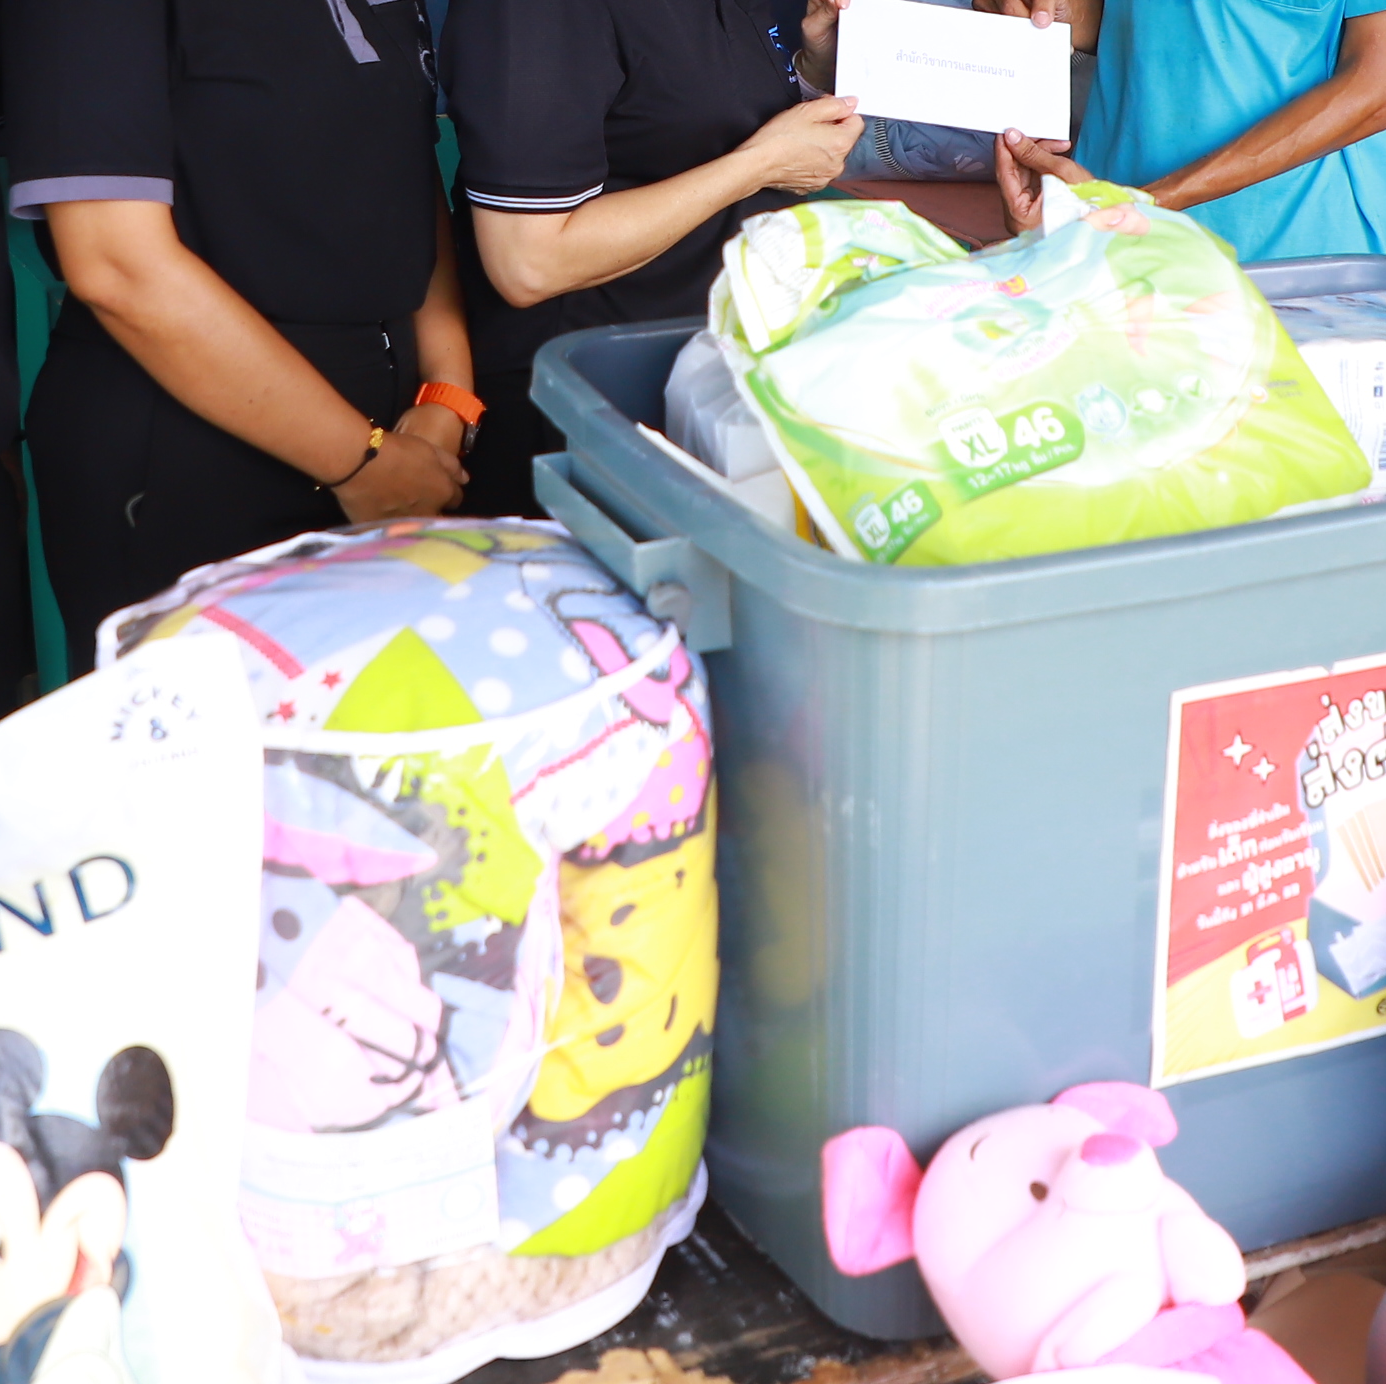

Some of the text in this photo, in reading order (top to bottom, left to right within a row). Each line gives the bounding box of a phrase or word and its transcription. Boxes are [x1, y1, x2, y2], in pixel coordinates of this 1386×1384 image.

[896, 49, 1015, 78] สำนักวิชาการและแผนงาน
[961, 407, 1065, 461] XL 46
[890, 489, 924, 524] 46
[1218, 833, 1258, 867] เด็ก
